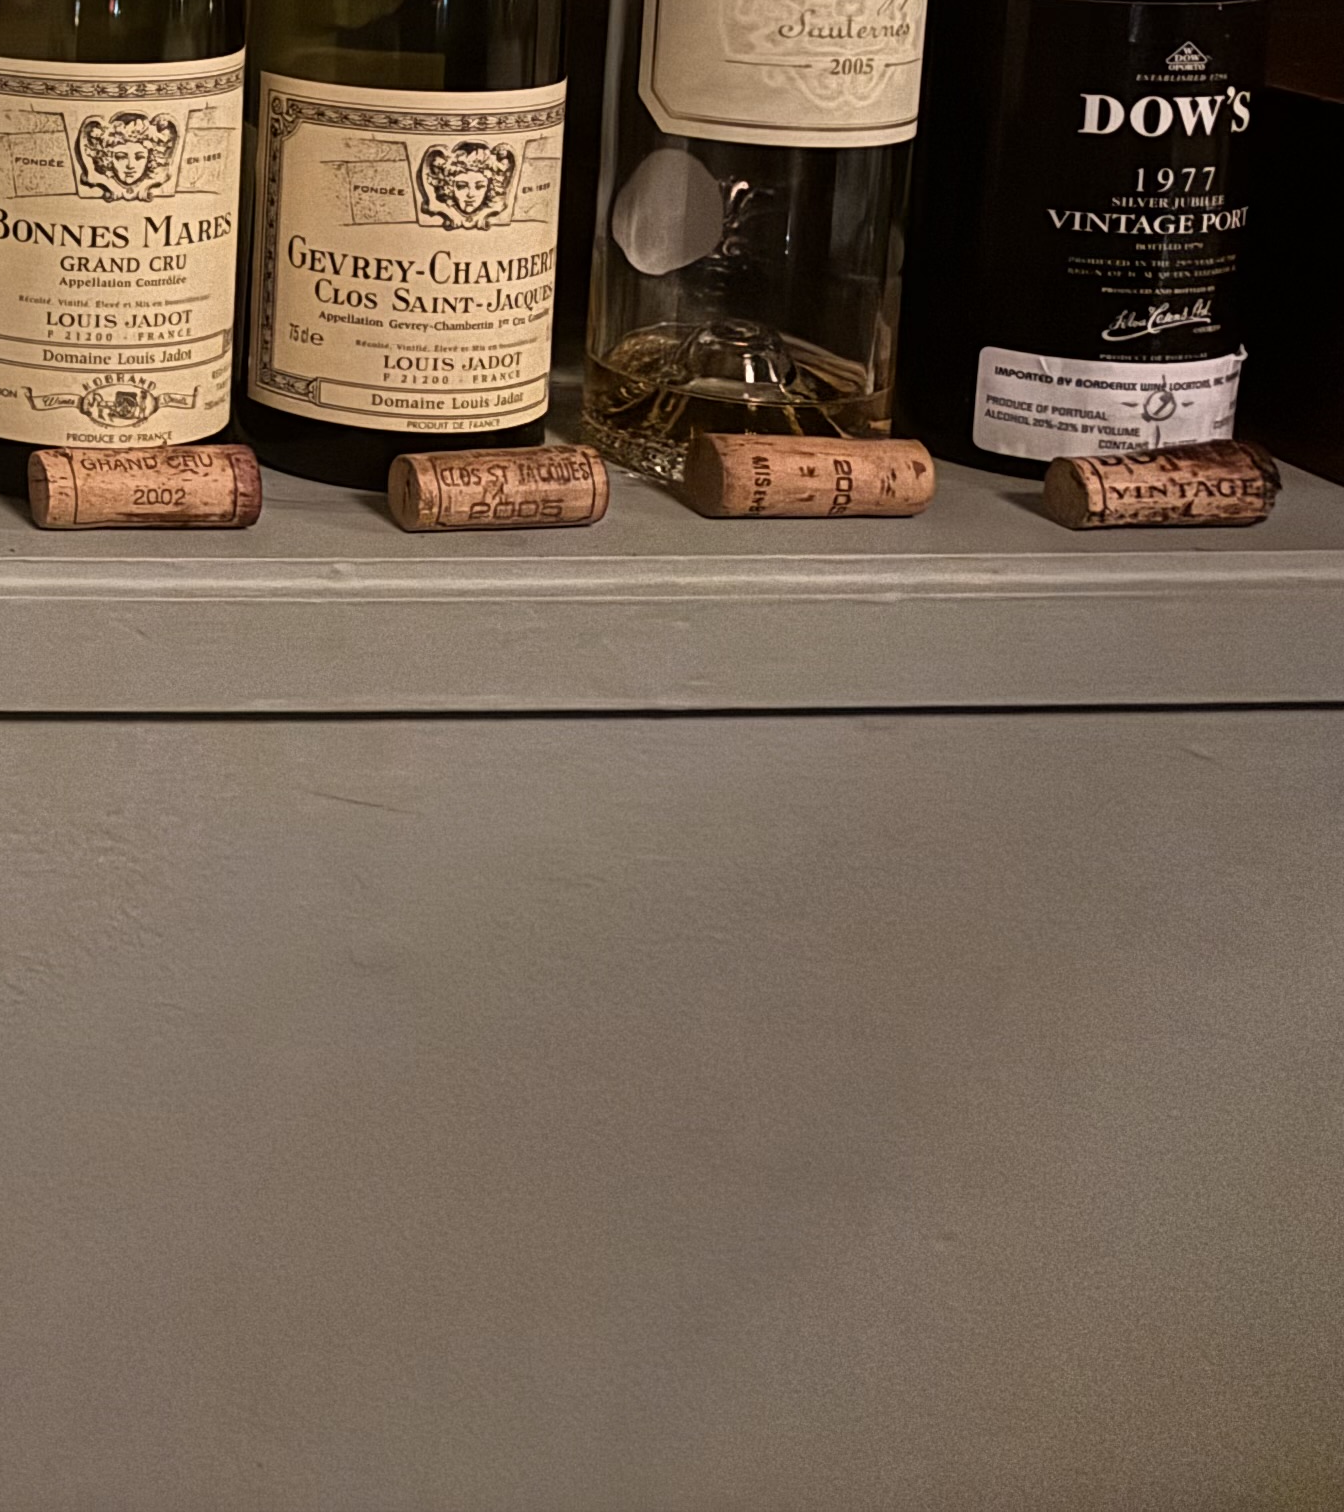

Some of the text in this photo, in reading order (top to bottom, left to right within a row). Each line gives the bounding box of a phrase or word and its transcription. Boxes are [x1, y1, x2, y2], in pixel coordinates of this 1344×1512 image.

[778, 8, 911, 40] Sauternes
[829, 58, 875, 76] 2005
[1174, 54, 1201, 62] DOW
[1077, 86, 1252, 138] DOW'S
[1135, 167, 1217, 193] 1977
[1112, 194, 1226, 209] SILVER JUBILEE
[144, 212, 232, 248] MARES
[1047, 205, 1250, 236] VINTAGE PORT
[1135, 242, 1182, 251] BOTTLED
[60, 254, 187, 273] GRAND CRU
[1068, 256, 1131, 267] PRODUCED
[59, 274, 187, 289] Appellation Contrôlée
[315, 278, 378, 310] CLOS
[46, 309, 193, 329] LOUIS JADOT
[319, 310, 494, 333] Appellation Gevrey-Chambertin
[64, 327, 192, 342] 21200 FRANCE
[42, 347, 192, 365] Domaine Louis Jadot
[383, 351, 523, 372] LOUIS JADOT
[401, 369, 521, 385] 21200 FRANCE
[995, 365, 1167, 393] IMPORTED BY BORDEAUX WINE
[371, 390, 525, 410] Domaine Louis Jadot
[986, 395, 1108, 421] PRODUCE OF PORTUGAL
[406, 418, 501, 430] PRODUIT DE FRANCE
[984, 409, 1031, 427] ALCOHOL
[1081, 423, 1095, 435] BY
[1097, 426, 1141, 437] VOLUME
[66, 431, 172, 444] PRODUCE OF FRANCE
[1098, 439, 1150, 450] CONTAINS
[81, 453, 213, 474] GRAND CRU
[440, 468, 482, 488] CLOS
[133, 488, 187, 506] 2002
[1109, 478, 1262, 500] VINTAGE
[469, 498, 565, 519] 2005
